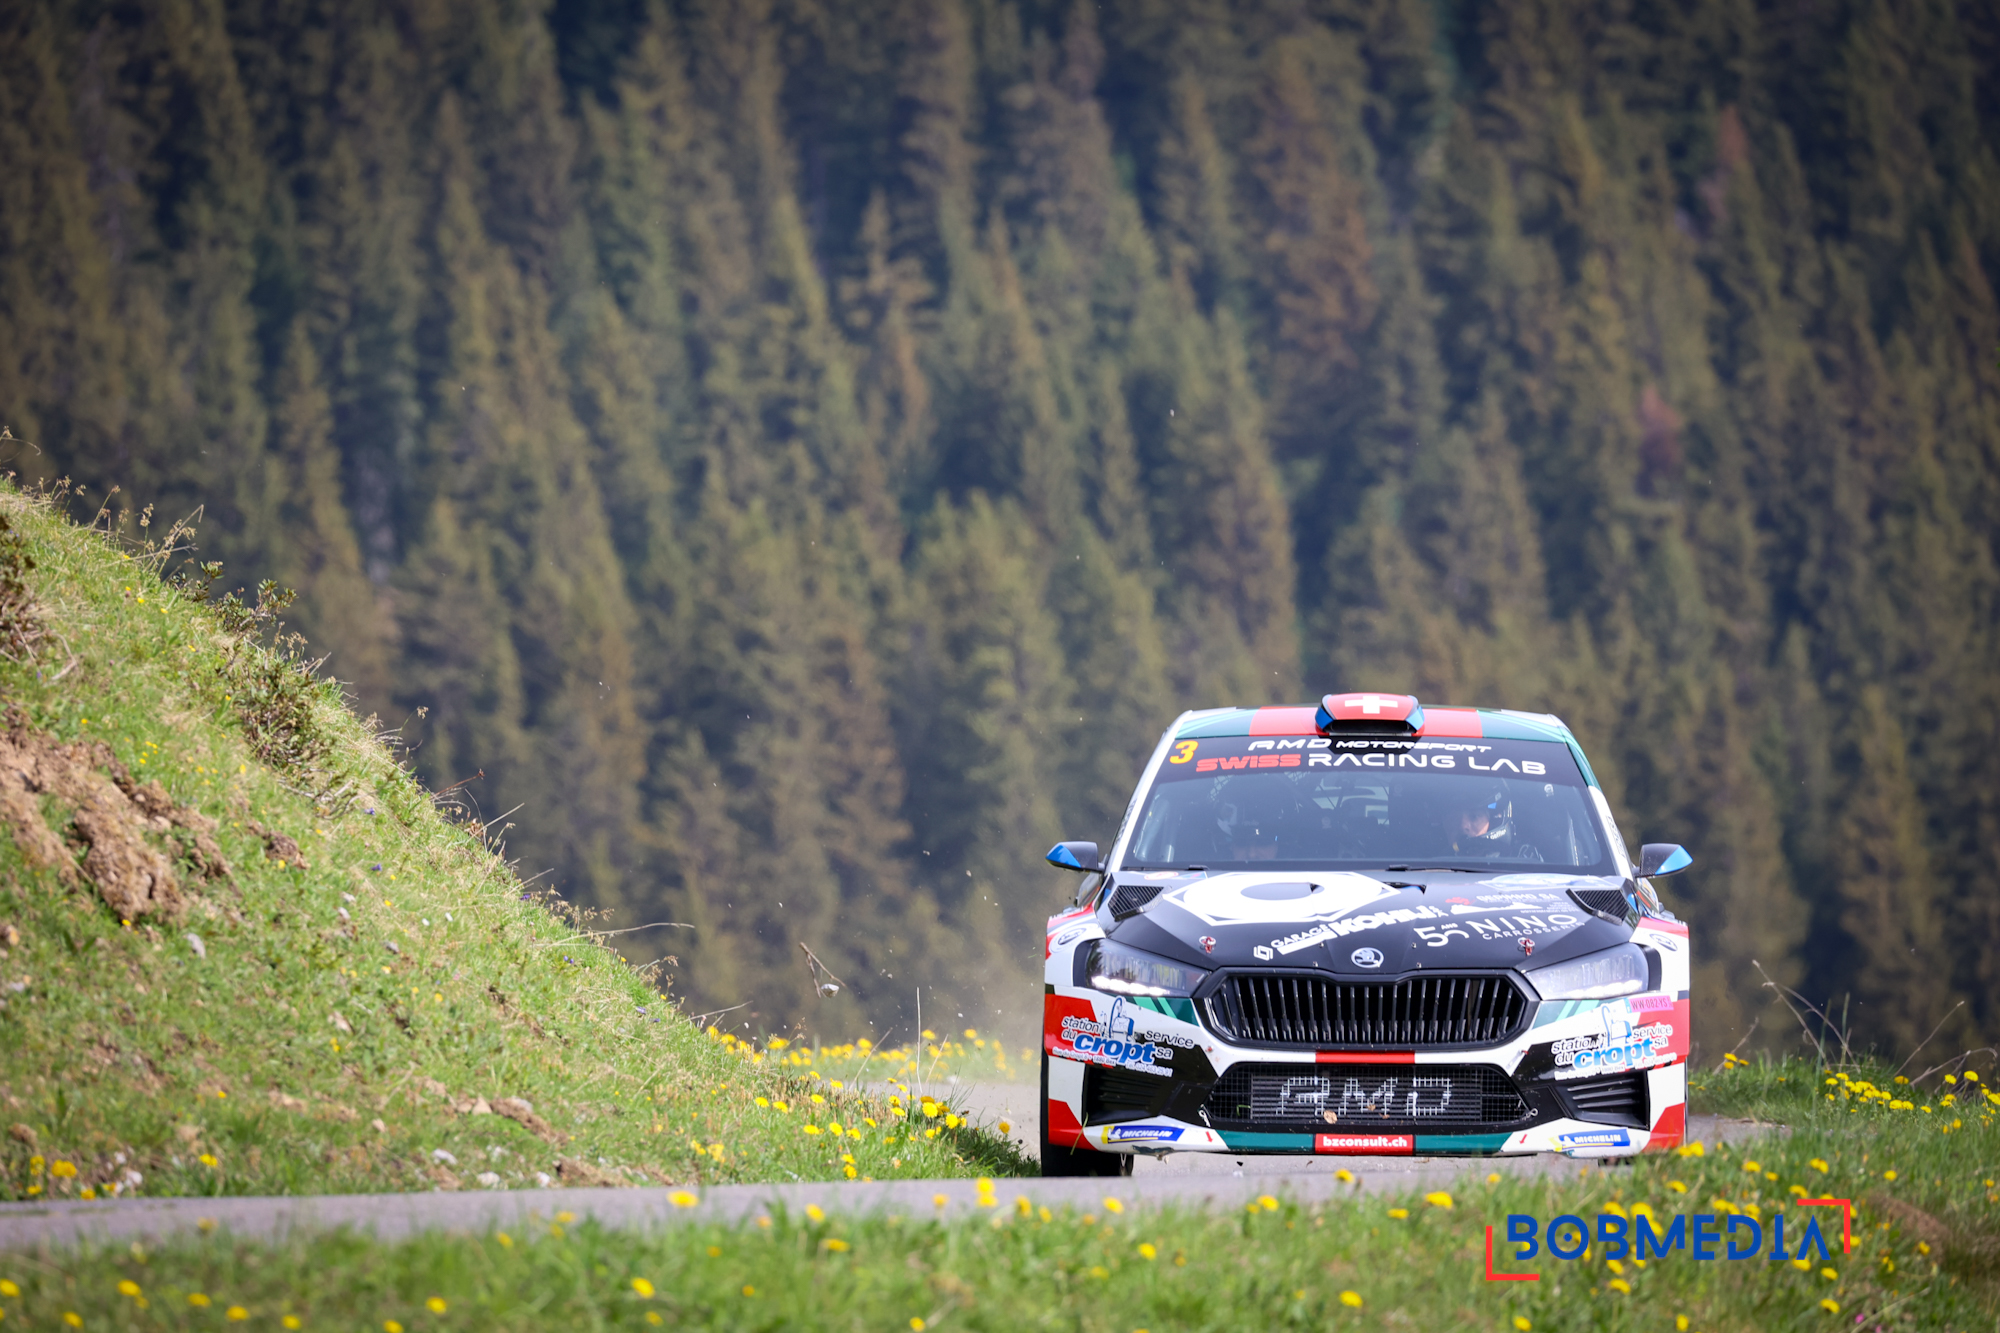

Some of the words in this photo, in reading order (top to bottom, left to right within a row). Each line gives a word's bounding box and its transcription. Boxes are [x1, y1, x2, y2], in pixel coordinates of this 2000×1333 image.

[1169, 740, 1199, 765] 3
[1247, 738, 1332, 751] AMD
[1336, 740, 1492, 753] MOTORSPORT
[1195, 754, 1301, 772] SWISS
[1308, 752, 1456, 769] RACING
[1468, 756, 1547, 775] LAB
[1465, 914, 1577, 934] NINO
[1482, 921, 1586, 940] CARROSSERIE
[1271, 924, 1330, 948] GARAGE
[1631, 997, 1668, 1011] WW-082-YS
[1062, 1016, 1099, 1033] station
[1145, 1030, 1194, 1048] service
[1632, 1024, 1673, 1040] service
[1062, 1029, 1076, 1040] du
[1074, 1034, 1156, 1064] cropt
[1156, 1048, 1171, 1058] sa
[1556, 1051, 1574, 1065] du
[1573, 1037, 1654, 1069] cropt
[1654, 1036, 1668, 1049] sa
[1276, 1076, 1452, 1117] AMD
[1122, 1128, 1173, 1138] MICHELIN
[1322, 1136, 1408, 1148] bzconsult.ch
[1574, 1134, 1621, 1144] MICHELIN
